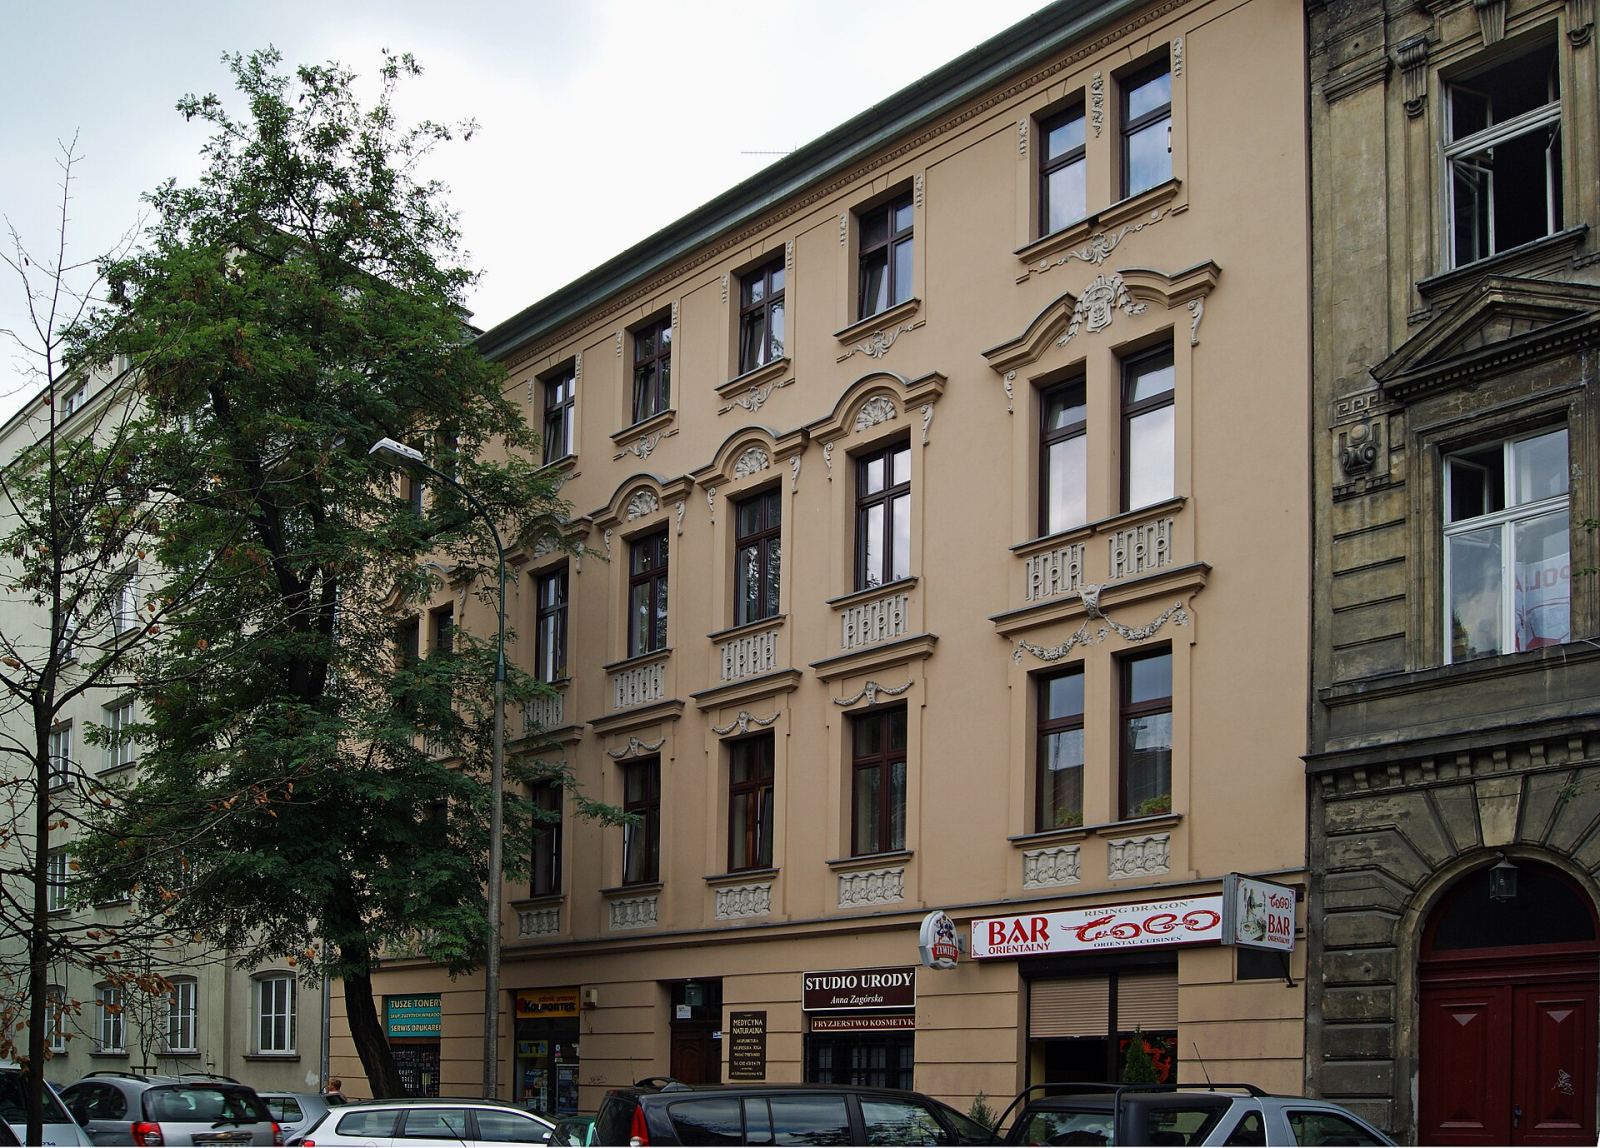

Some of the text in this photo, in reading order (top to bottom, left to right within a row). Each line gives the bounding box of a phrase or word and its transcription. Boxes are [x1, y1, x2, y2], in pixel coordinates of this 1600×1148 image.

[1084, 902, 1188, 917] RISING DRAGON
[988, 916, 1050, 946] BAR
[1268, 913, 1290, 937] BAR
[1093, 936, 1182, 948] ORIENTAL CUISINES
[988, 942, 1050, 955] ORIENTALNY
[805, 972, 914, 991] STUDIO URODY
[390, 998, 442, 1008] TUSZE TONERY
[830, 994, 883, 1006] Anna Zagórska
[391, 1024, 411, 1032] SERWIS
[732, 1019, 763, 1027] MEDYCYNA
[814, 1020, 869, 1028] FRYZJERSTWO
[732, 1027, 763, 1035] NATURALNA
